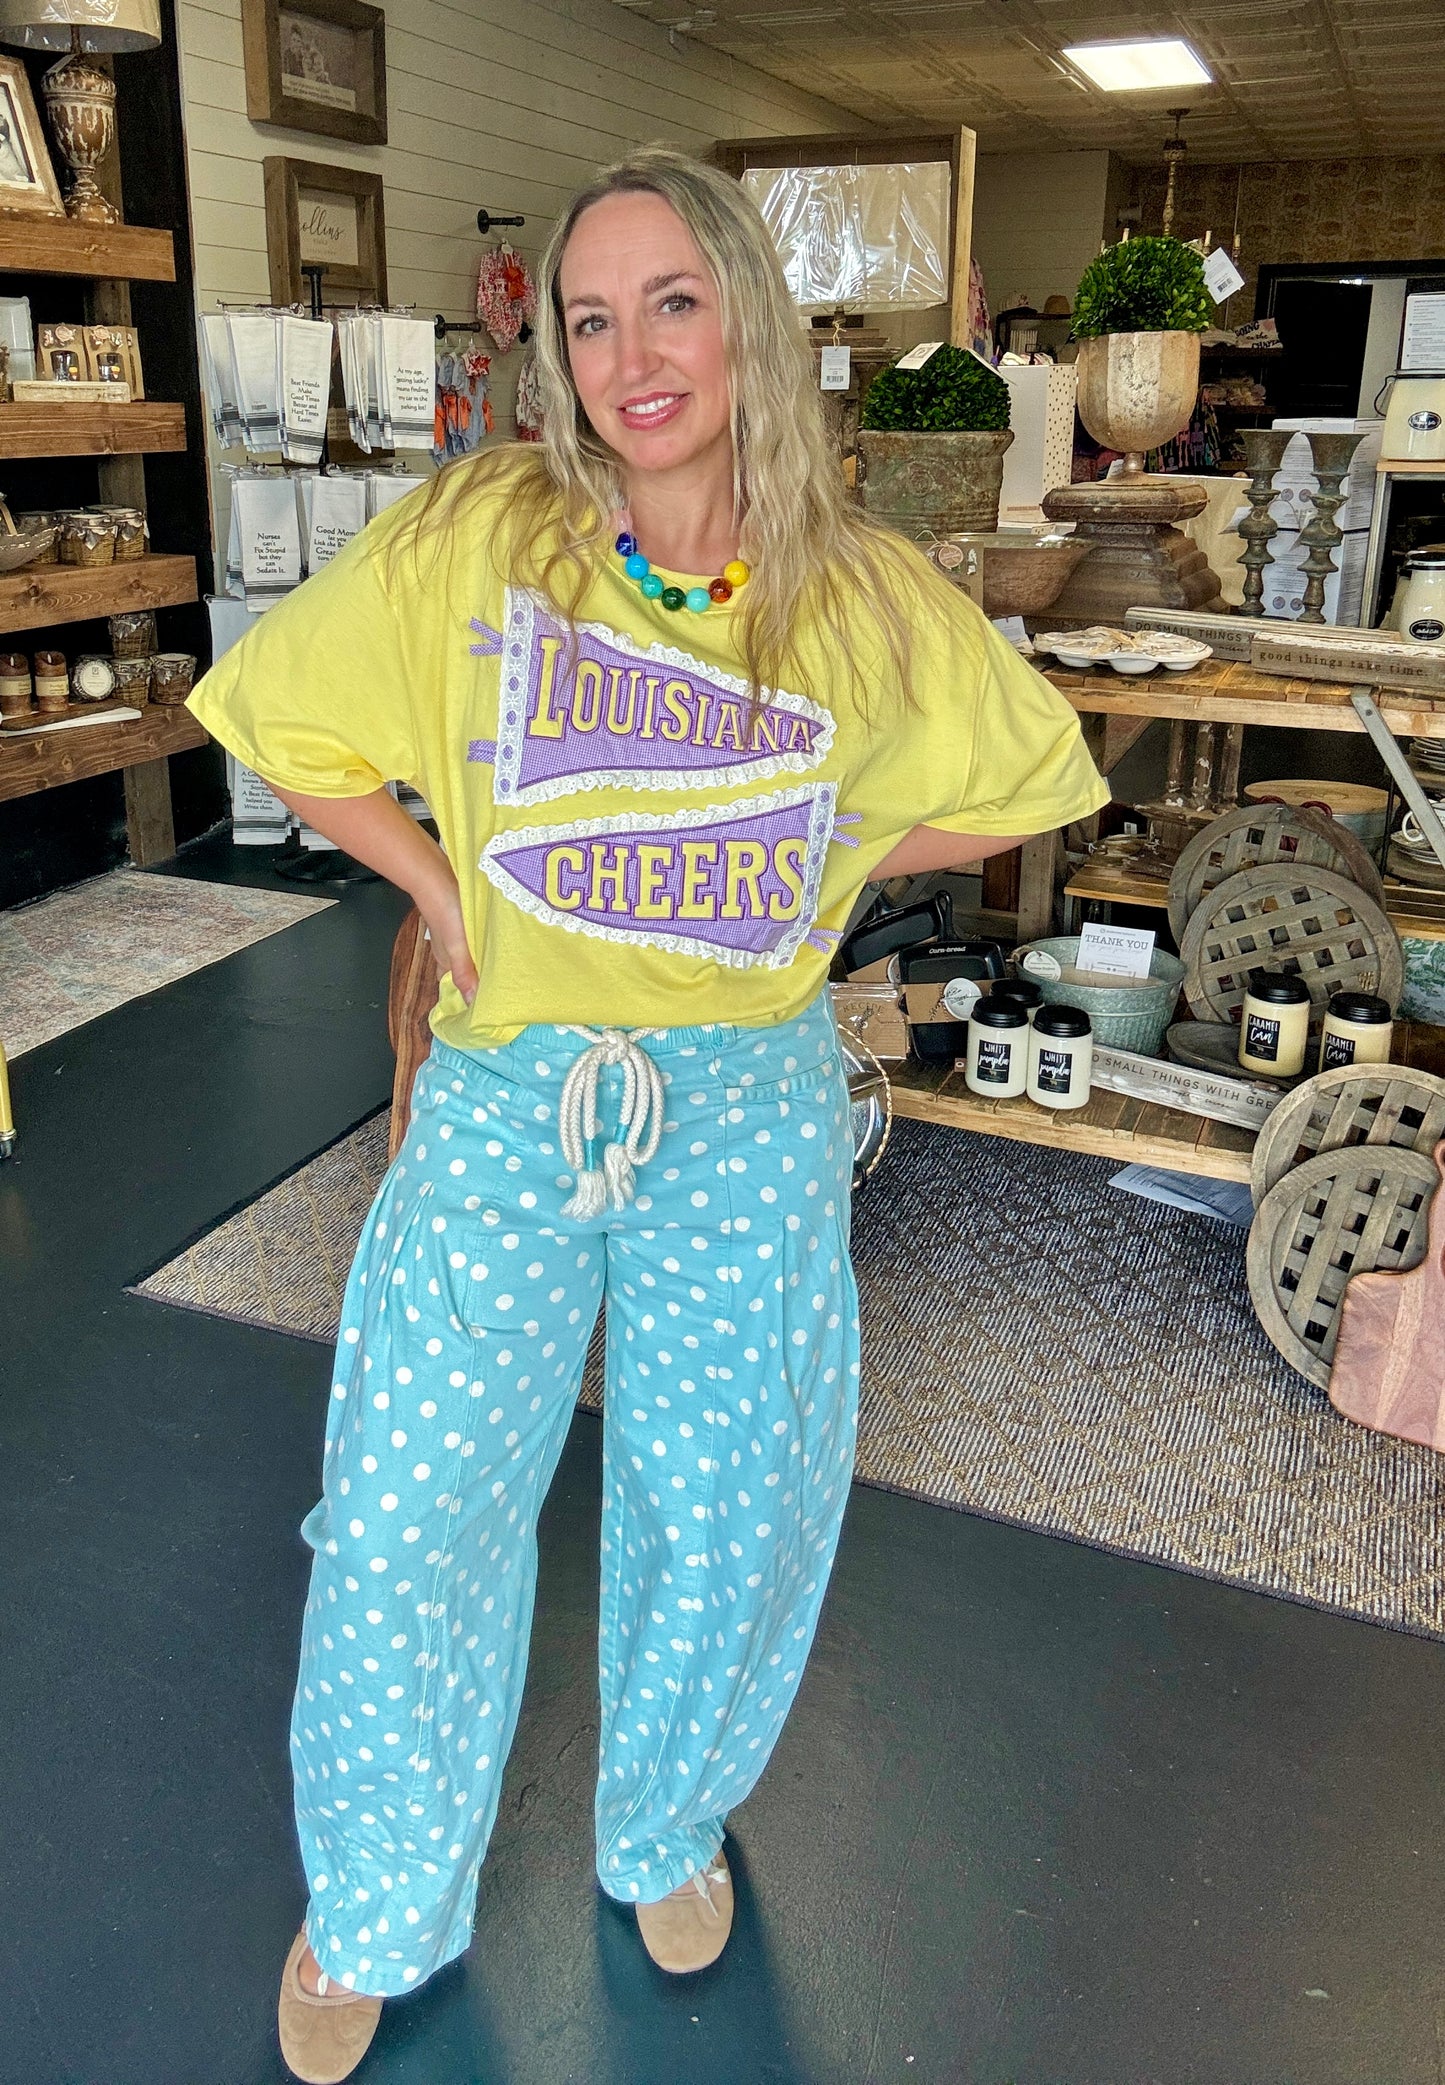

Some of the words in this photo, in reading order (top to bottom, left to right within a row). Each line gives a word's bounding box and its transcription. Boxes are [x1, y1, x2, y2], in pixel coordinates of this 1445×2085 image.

[257, 532, 281, 540] Nurses
[315, 525, 336, 535] Good
[337, 528, 357, 537] Mom
[254, 546, 264, 554] Fix
[265, 546, 286, 555] Stupid
[1135, 621, 1151, 631] DO
[1156, 624, 1193, 637] SMALL
[1199, 629, 1242, 643] THINGS
[1259, 650, 1292, 663] good
[1299, 653, 1344, 670] things
[1349, 659, 1382, 673] take
[1389, 663, 1429, 678] time.
[527, 635, 815, 756] LOUISIANA
[542, 837, 808, 922] CHEERS
[1084, 934, 1124, 947] THANK
[1125, 939, 1149, 950] YOU
[1248, 1015, 1279, 1032] CARAMEL
[1250, 1027, 1274, 1045] Corn
[1325, 1033, 1354, 1052] CARAMEL
[984, 1042, 1006, 1055] WHITE
[1326, 1047, 1348, 1064] Corn
[1044, 1051, 1067, 1065] WHITE
[1105, 1057, 1146, 1077] SMALL
[1152, 1070, 1201, 1091] THINGS
[1206, 1083, 1241, 1102] WITH
[1246, 1095, 1274, 1112] GRE
